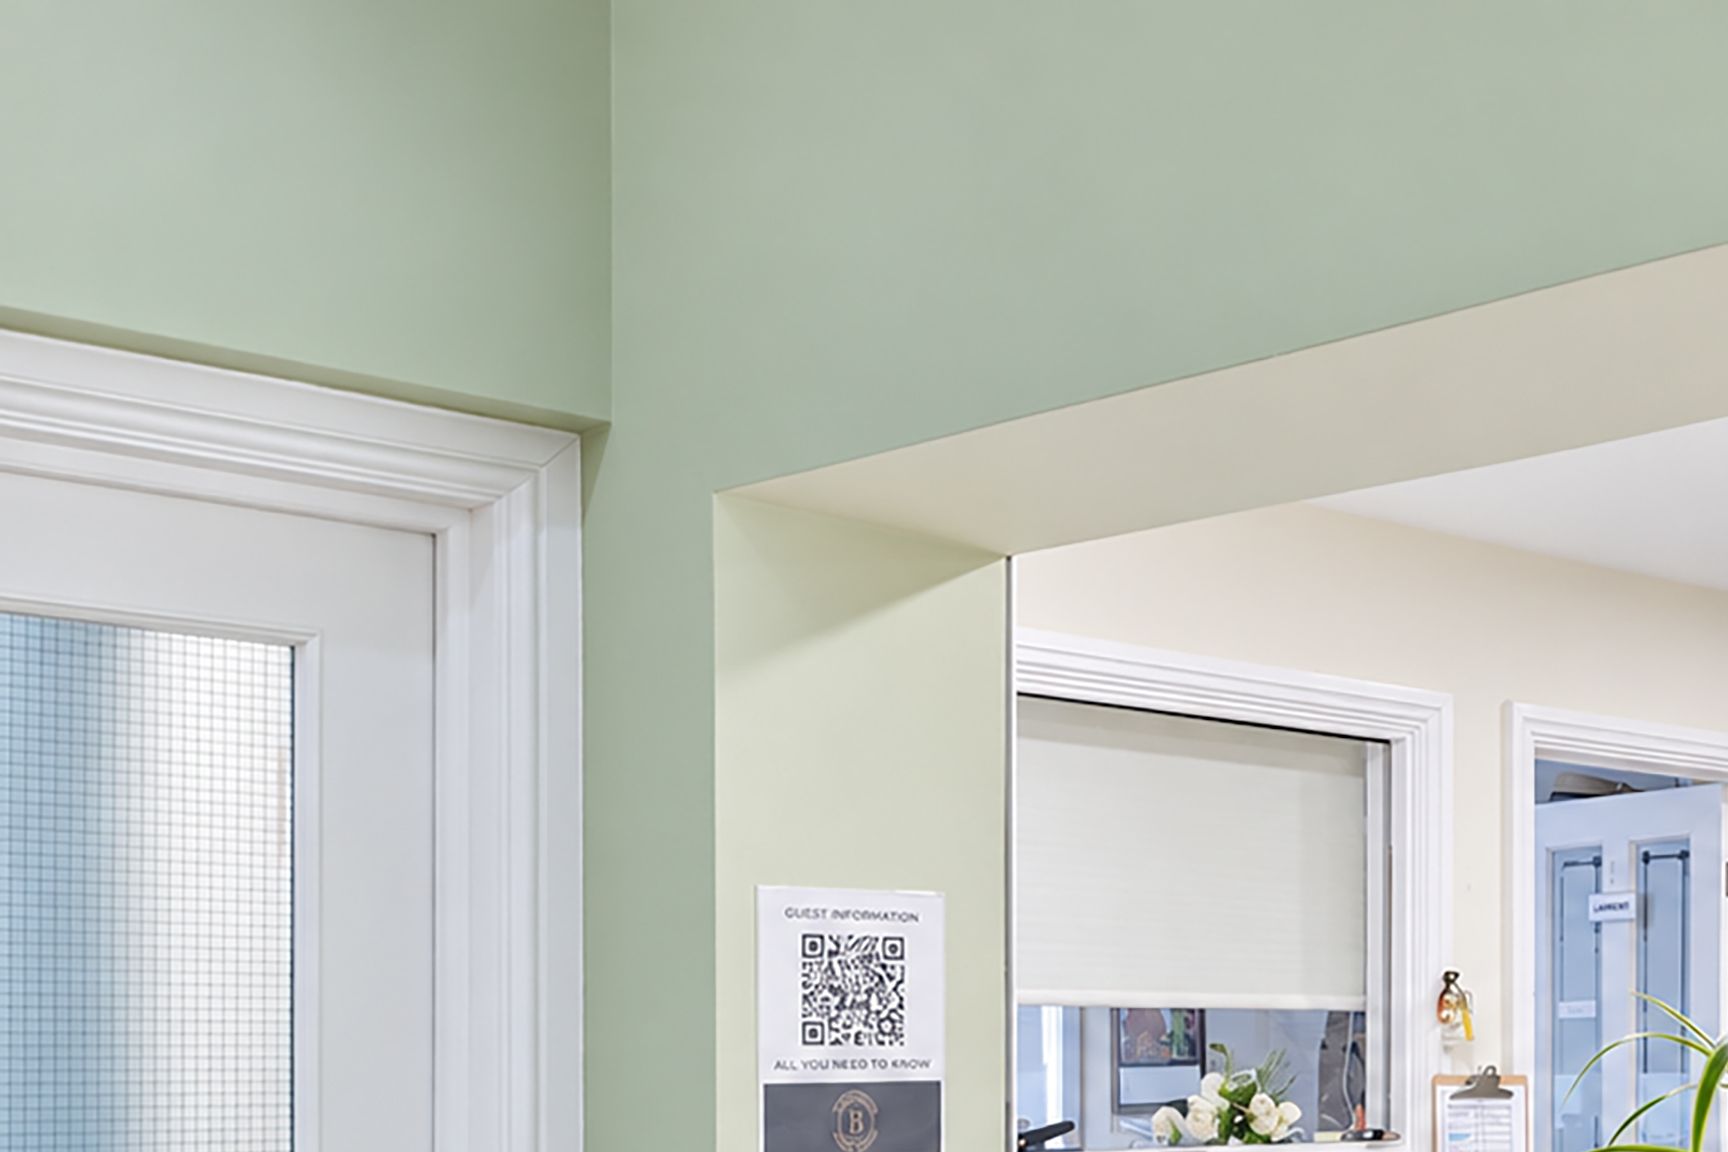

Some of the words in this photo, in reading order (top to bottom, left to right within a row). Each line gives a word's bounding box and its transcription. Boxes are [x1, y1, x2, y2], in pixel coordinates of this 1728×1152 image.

[784, 907, 827, 919] GUEST
[831, 909, 919, 922] INFORMATION
[774, 1060, 797, 1070] ALL
[801, 1059, 829, 1070] YOU
[832, 1059, 868, 1070] NEED
[871, 1059, 888, 1069] TO
[891, 1058, 932, 1069] KNOW
